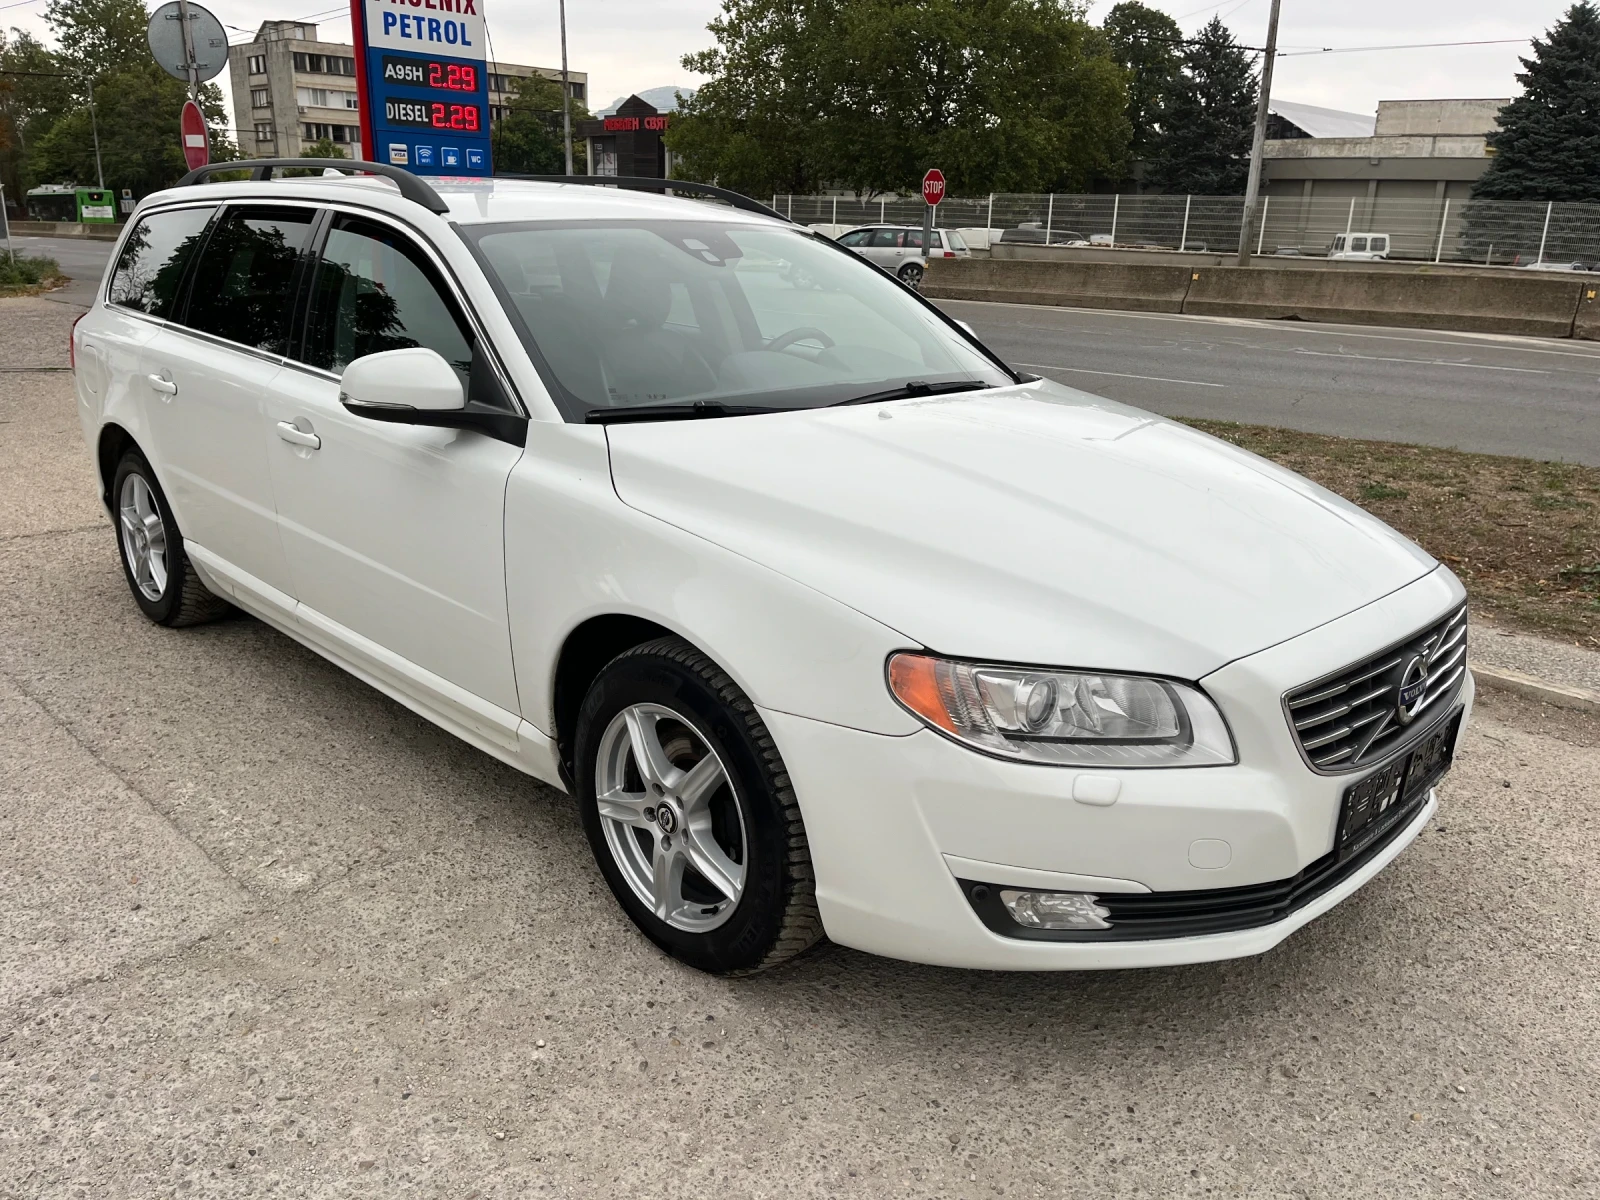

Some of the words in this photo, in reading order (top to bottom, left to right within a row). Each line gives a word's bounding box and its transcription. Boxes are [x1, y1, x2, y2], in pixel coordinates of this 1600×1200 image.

[383, 11, 472, 46] PETROL
[385, 63, 423, 81] A95H
[429, 63, 475, 91] 2.29
[386, 102, 429, 122] DIESEL
[432, 103, 478, 130] 2.29
[470, 155, 481, 163] WC
[925, 180, 943, 194] STOP
